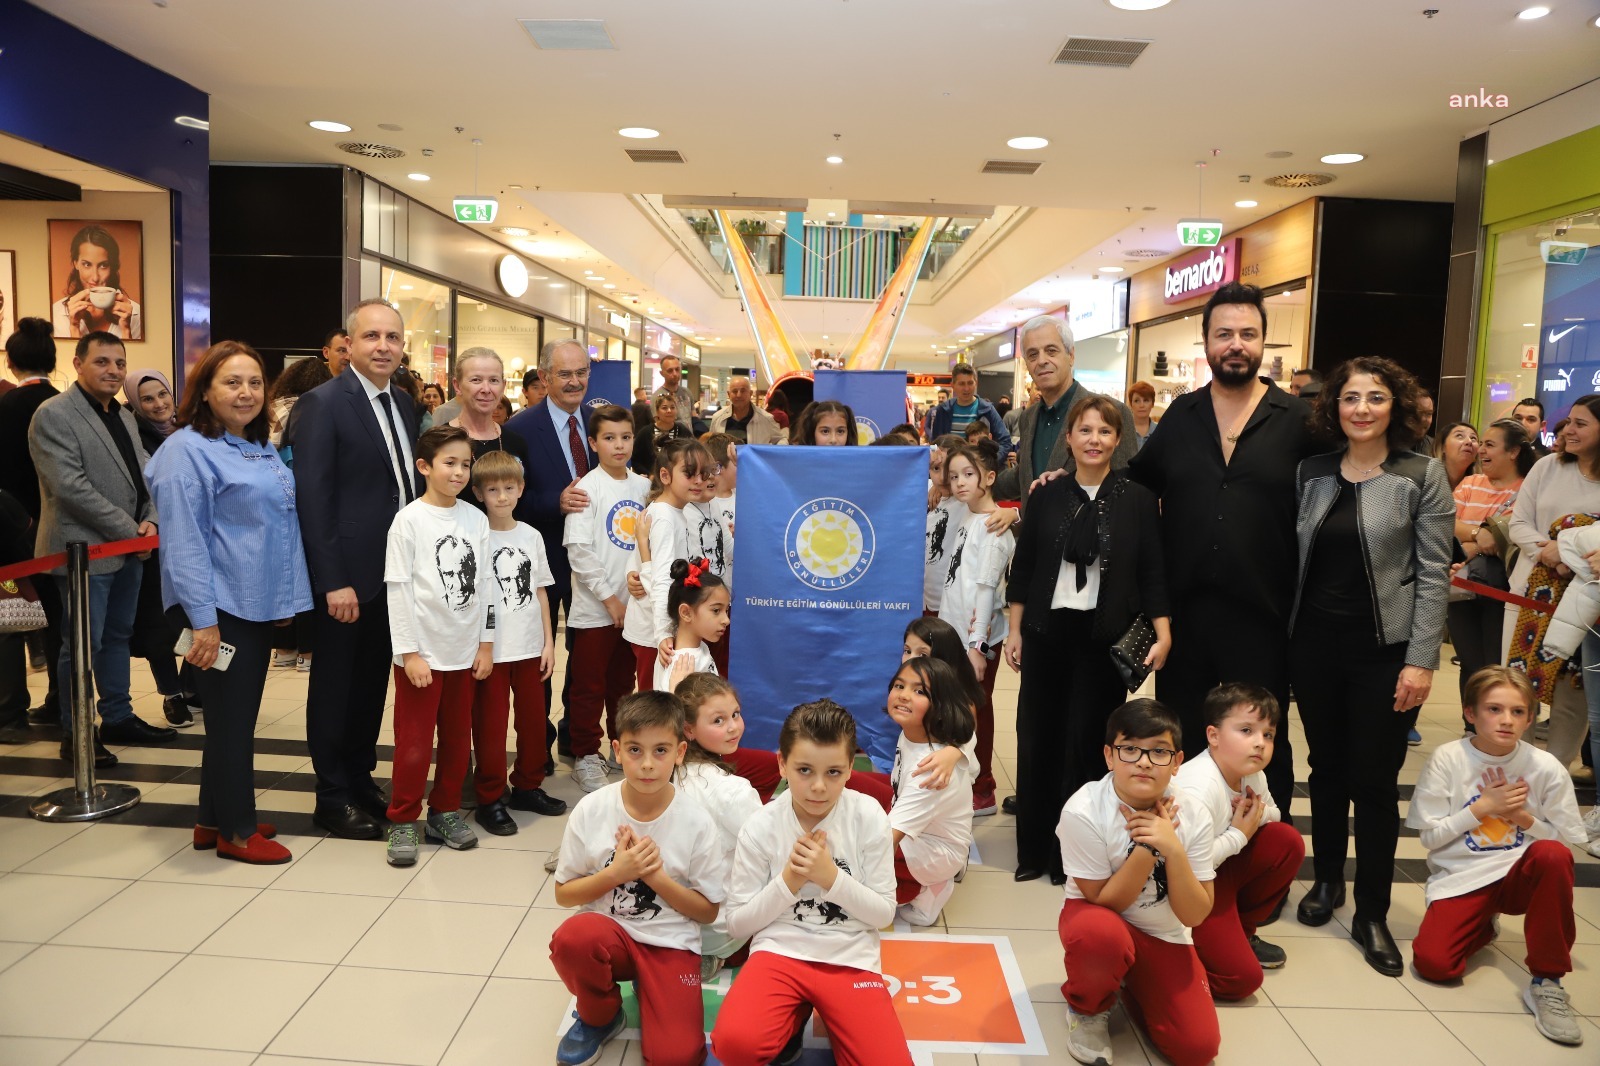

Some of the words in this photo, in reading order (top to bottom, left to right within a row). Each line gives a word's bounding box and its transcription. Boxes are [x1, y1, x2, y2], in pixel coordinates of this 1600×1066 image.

[1164, 248, 1225, 298] bernardo
[914, 376, 935, 384] FLO
[803, 501, 855, 516] EĞİTİM
[789, 550, 871, 587] GÖNÜLLÜLERİ
[745, 596, 784, 608] TÜRKİYE
[786, 598, 817, 609] EĞİTİM
[819, 600, 881, 610] GÖNÜLLÜLERİ
[883, 602, 910, 611] VAKFI
